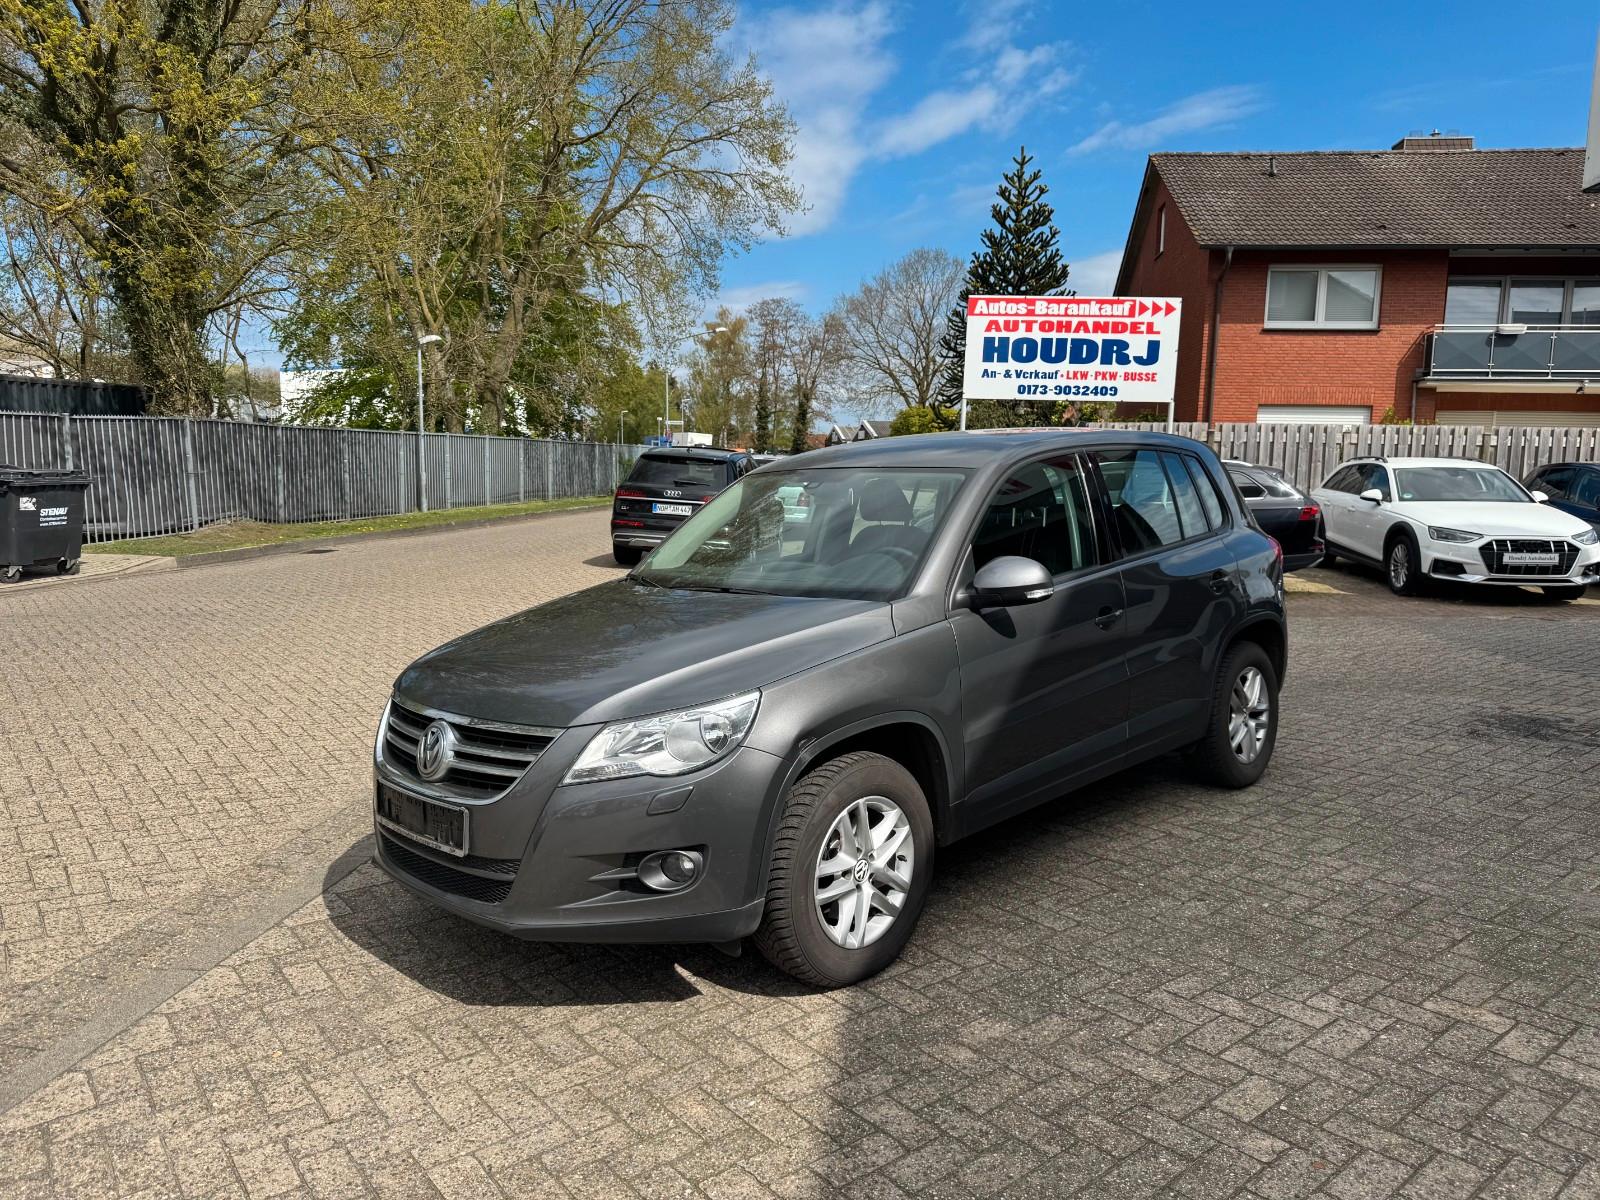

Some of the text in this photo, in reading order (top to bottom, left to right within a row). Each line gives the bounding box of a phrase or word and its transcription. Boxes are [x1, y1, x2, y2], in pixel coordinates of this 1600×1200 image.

[974, 300, 1134, 316] Autos-Barankauf
[984, 319, 1161, 335] AUTOHANDEL
[982, 336, 1161, 366] HOUDRJ
[981, 368, 1001, 379] An-
[1003, 369, 1012, 379] &
[1066, 370, 1089, 380] LKW
[1094, 371, 1118, 381] PKW
[1123, 371, 1157, 382] BUSSE
[1017, 384, 1118, 396] 0173-9032409
